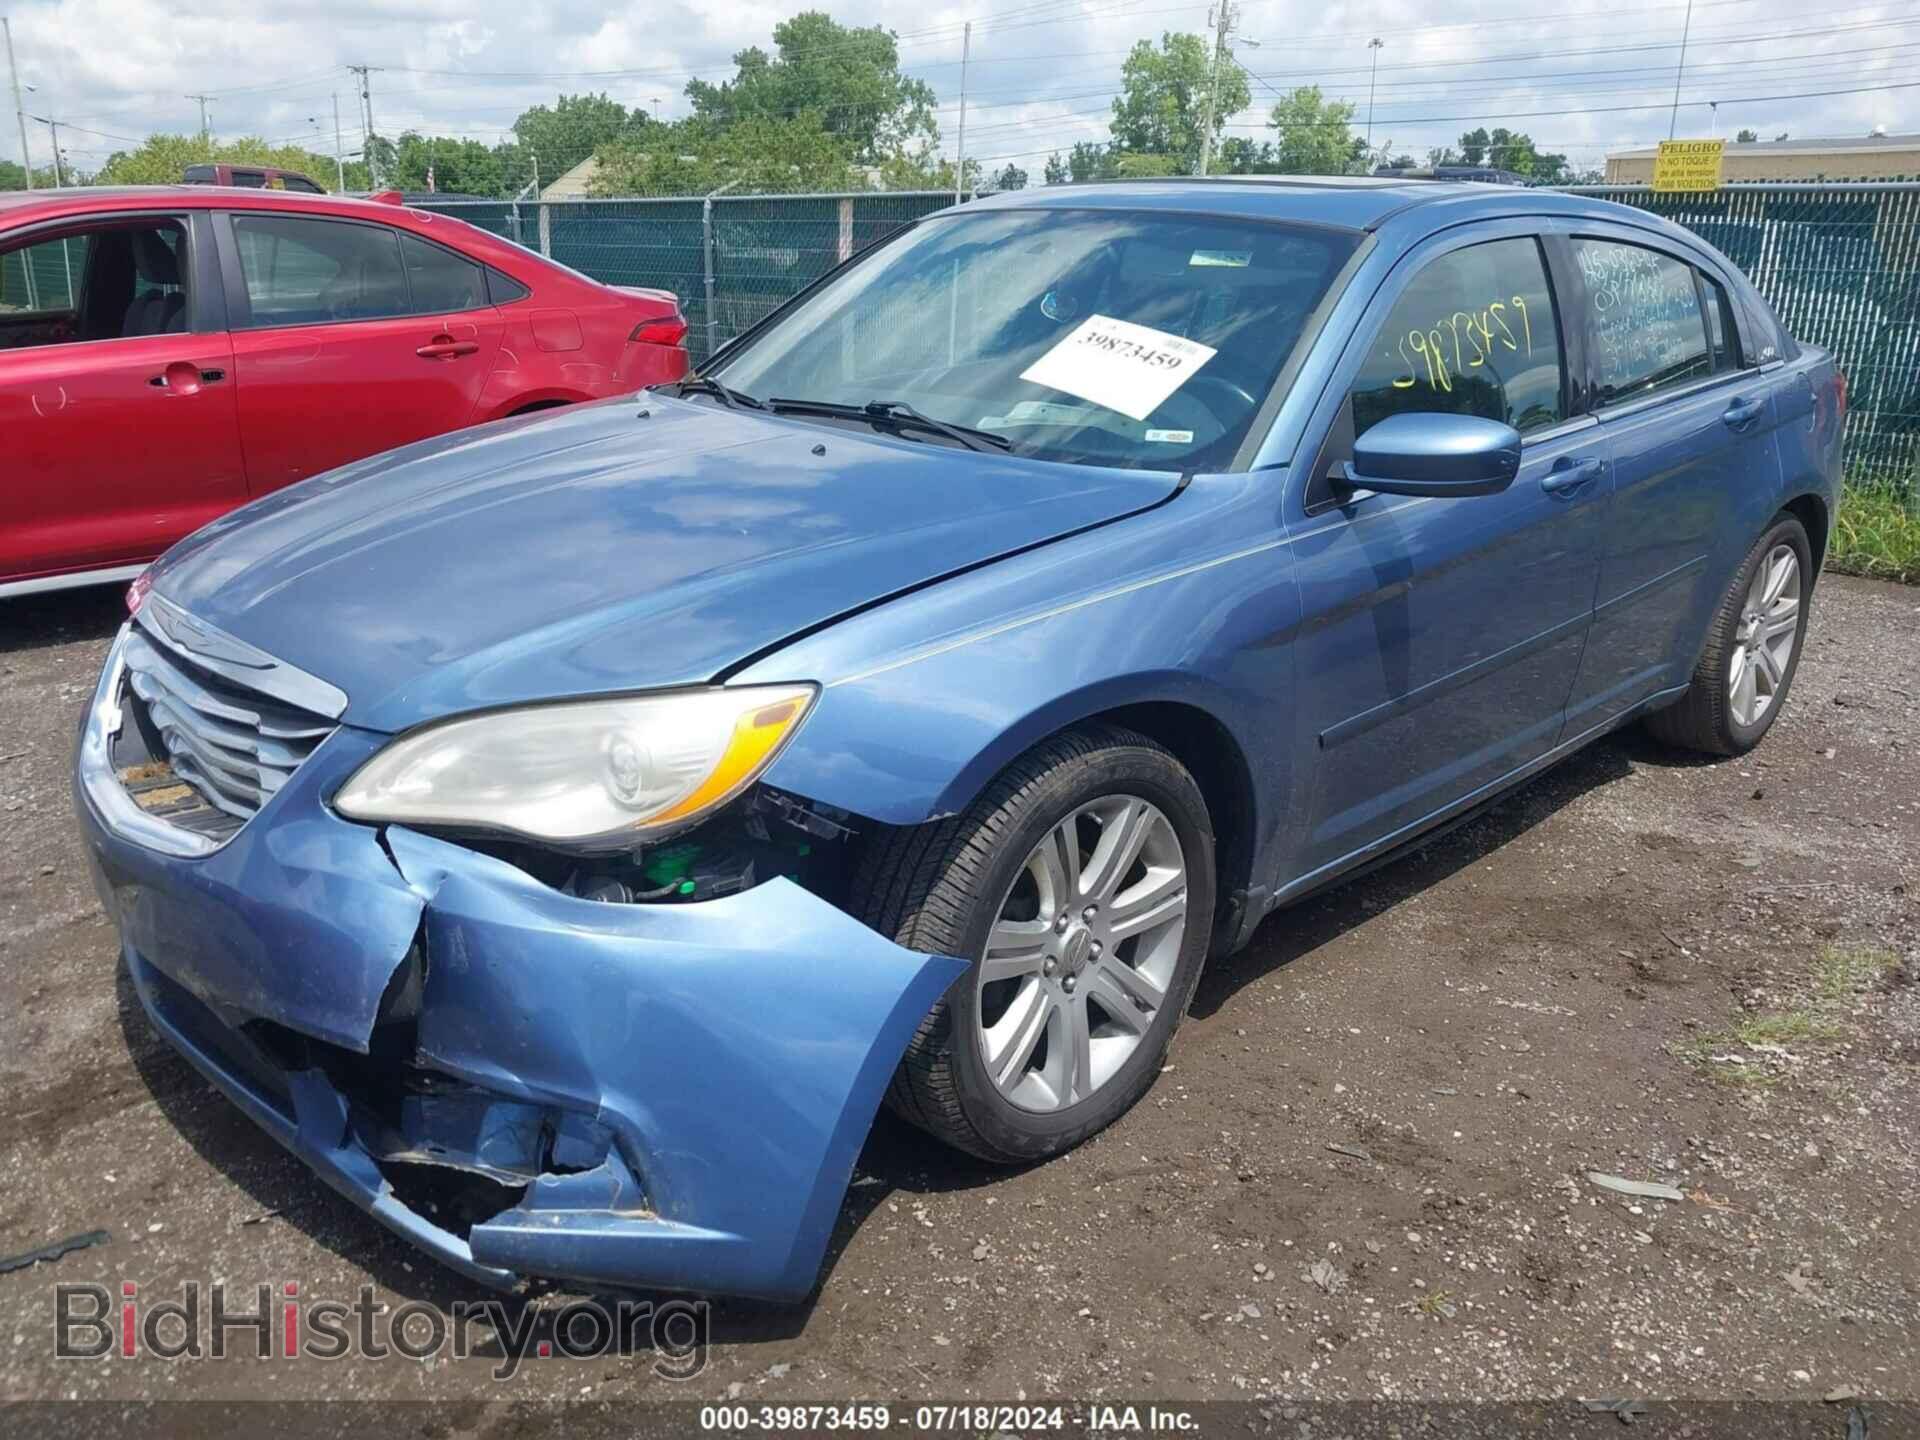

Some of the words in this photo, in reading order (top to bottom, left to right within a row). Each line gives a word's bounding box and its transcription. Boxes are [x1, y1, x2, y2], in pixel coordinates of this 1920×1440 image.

[1661, 142, 1722, 154] PELIGRO
[1668, 157, 1680, 167] NO
[1682, 155, 1710, 166] TOQUE
[1078, 331, 1183, 371] 39873459
